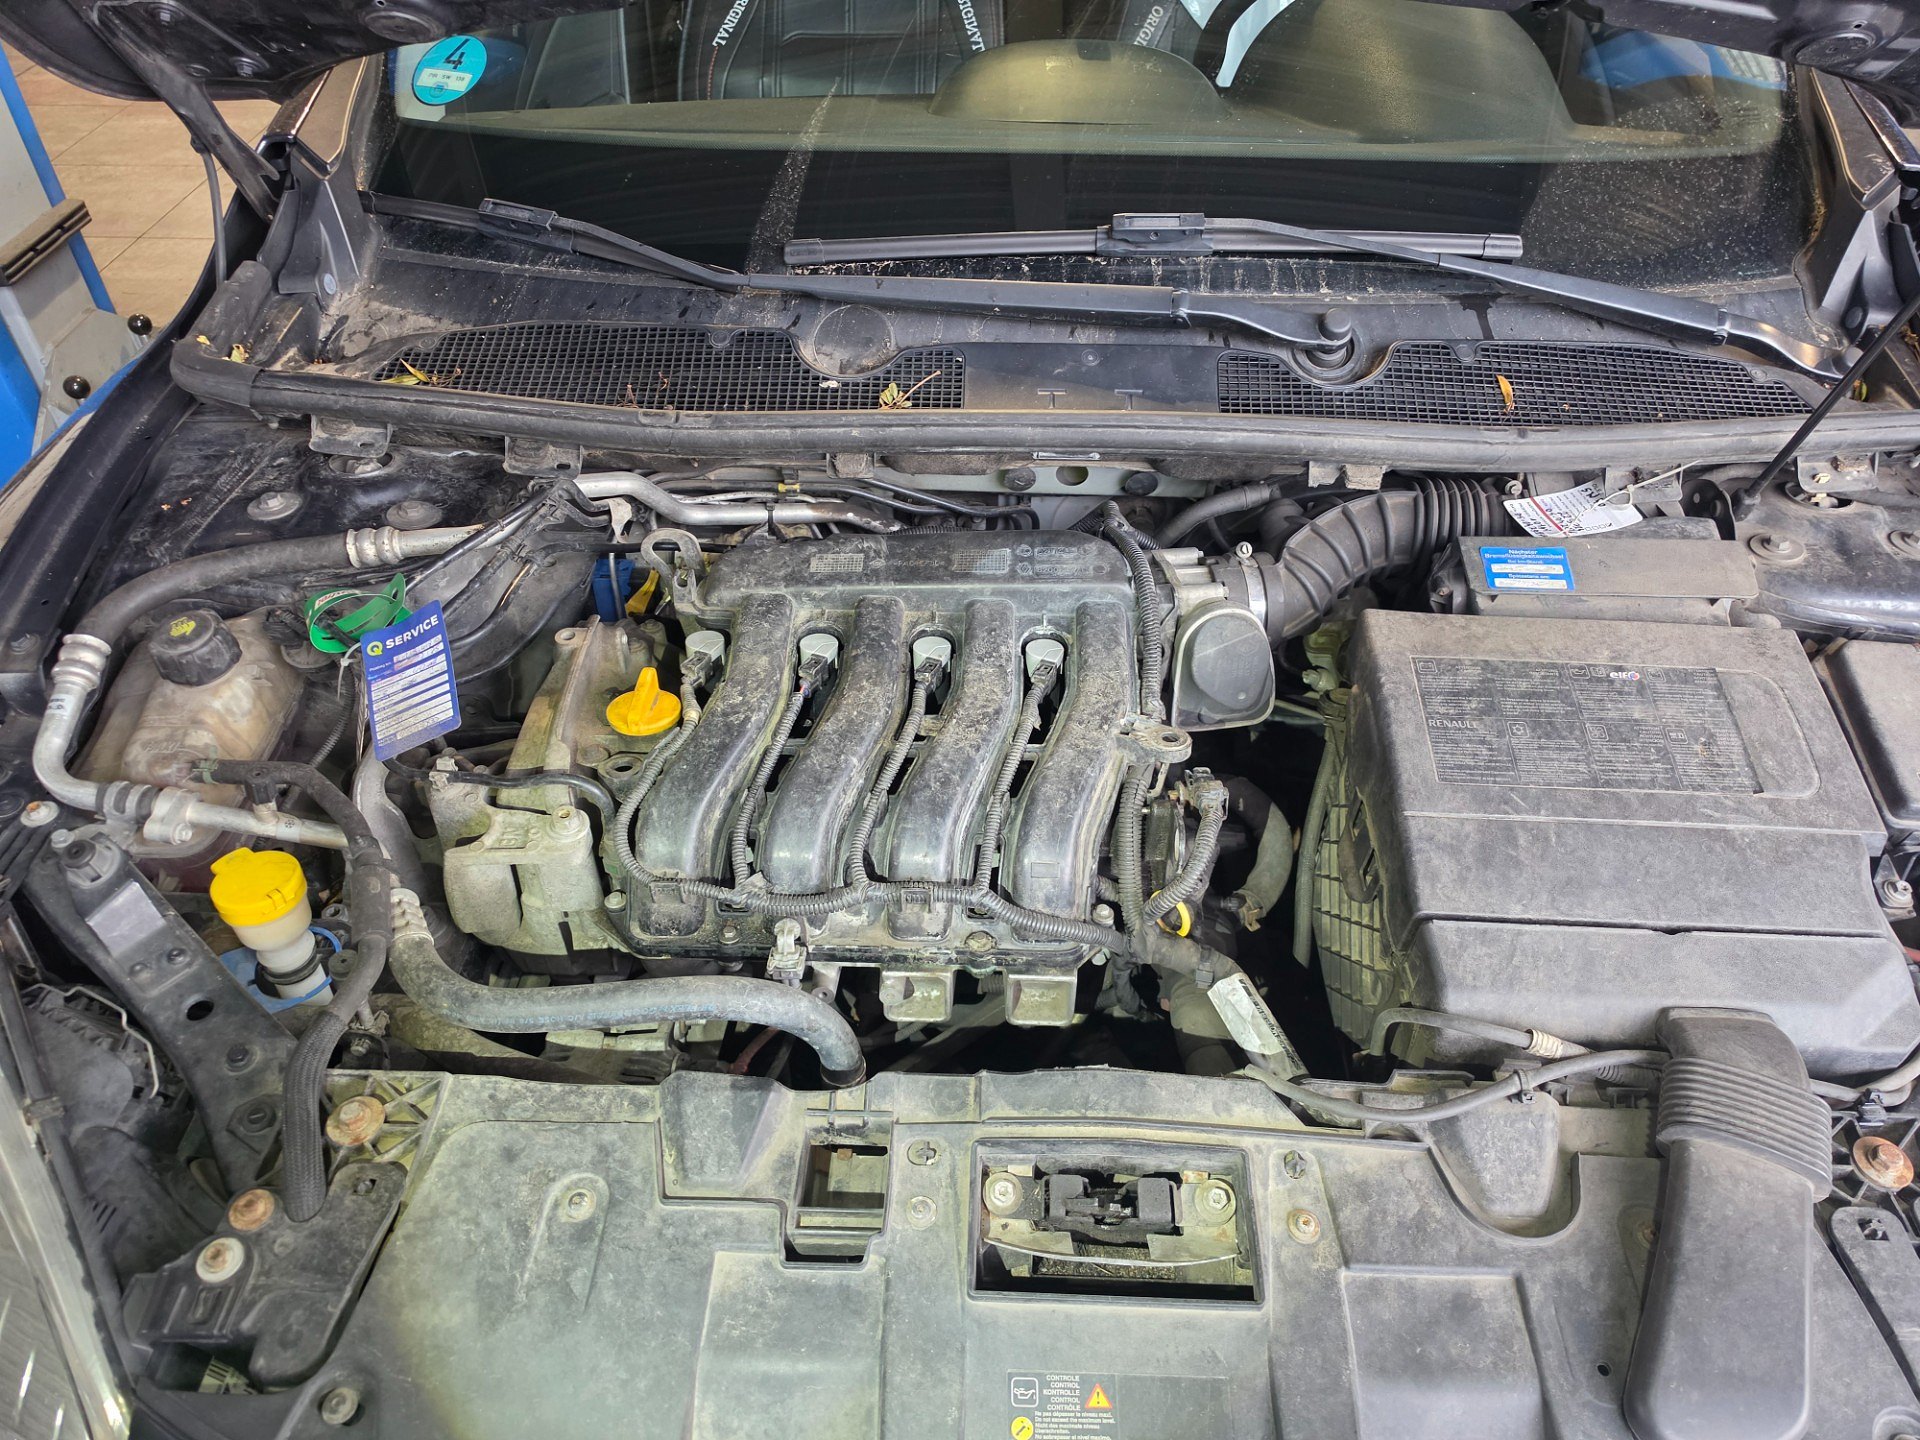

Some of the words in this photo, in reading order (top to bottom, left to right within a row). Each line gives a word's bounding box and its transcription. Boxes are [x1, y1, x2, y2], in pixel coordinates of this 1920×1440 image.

[443, 38, 471, 69] 4
[367, 641, 382, 656] Q
[386, 615, 439, 649] SERVICE
[1428, 719, 1478, 729] RENAULT
